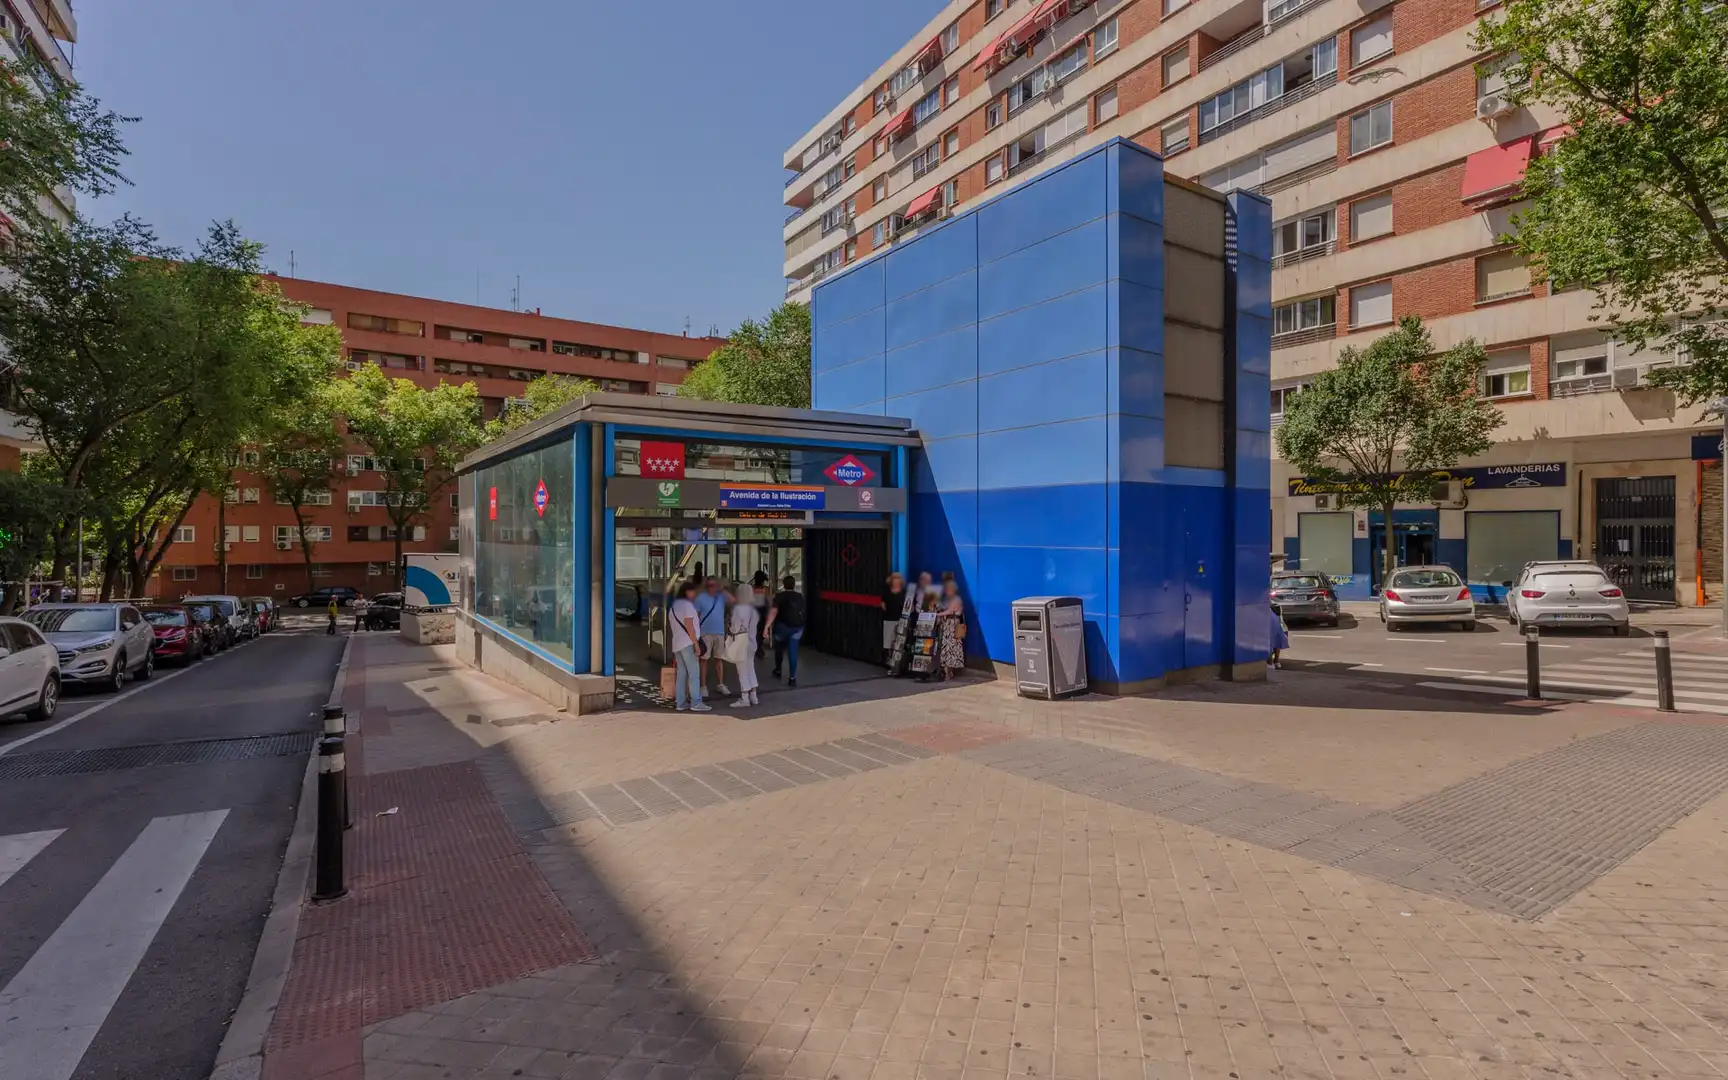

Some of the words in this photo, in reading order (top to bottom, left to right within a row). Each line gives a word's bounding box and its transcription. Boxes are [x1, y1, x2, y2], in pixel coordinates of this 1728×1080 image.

[837, 468, 862, 478] Metro
[1487, 463, 1561, 475] LAVANDERIAS
[729, 490, 760, 500] Avenida
[760, 491, 771, 500] de
[771, 491, 779, 500] la
[779, 491, 817, 501] Ilustración
